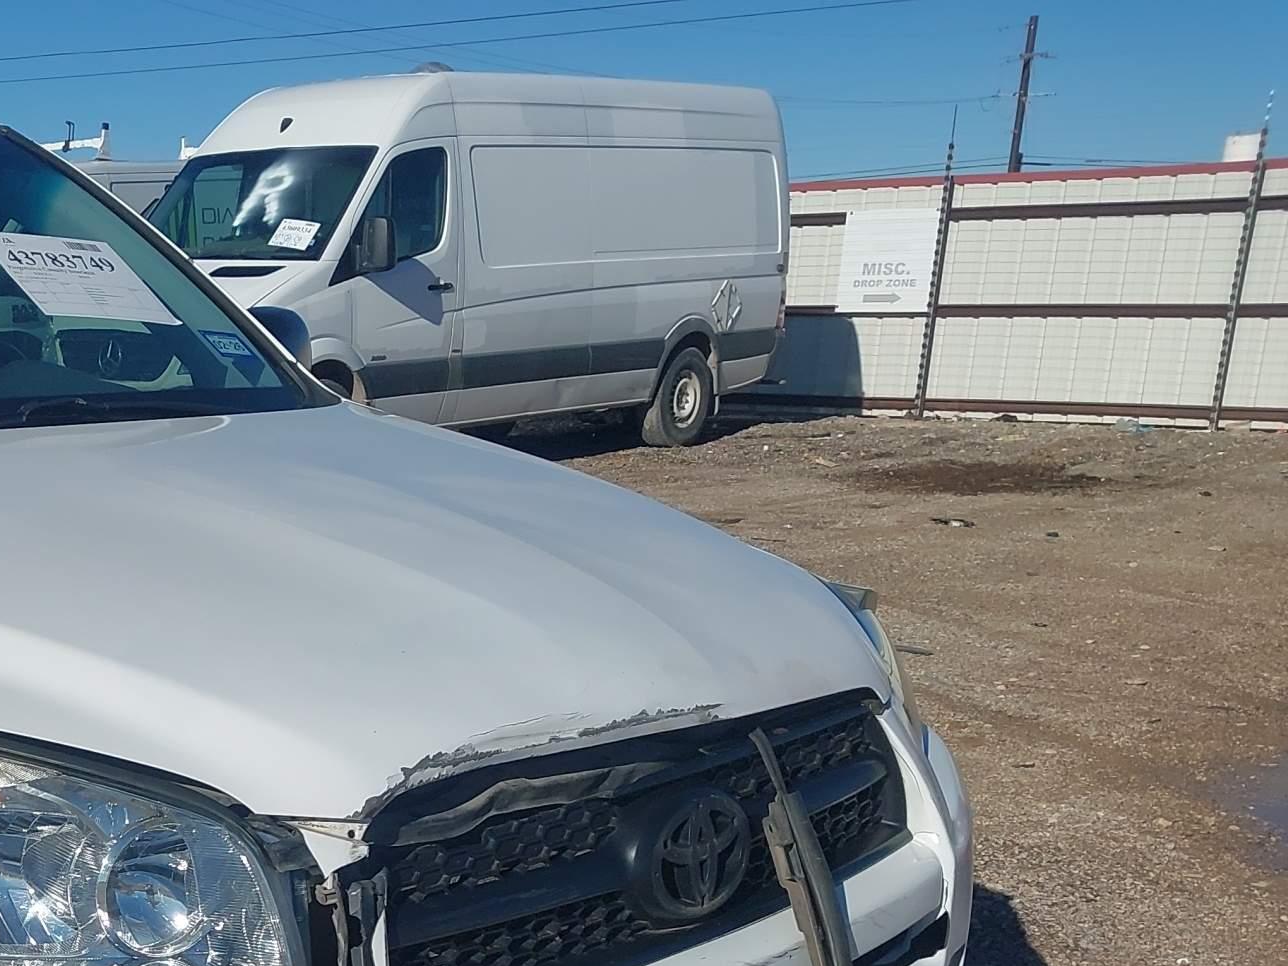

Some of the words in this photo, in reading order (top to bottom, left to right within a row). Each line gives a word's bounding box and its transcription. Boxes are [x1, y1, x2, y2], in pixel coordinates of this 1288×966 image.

[7, 250, 115, 272] 43783749
[862, 262, 911, 276] MISC.
[853, 280, 883, 288] DROP
[885, 279, 917, 288] ZONE
